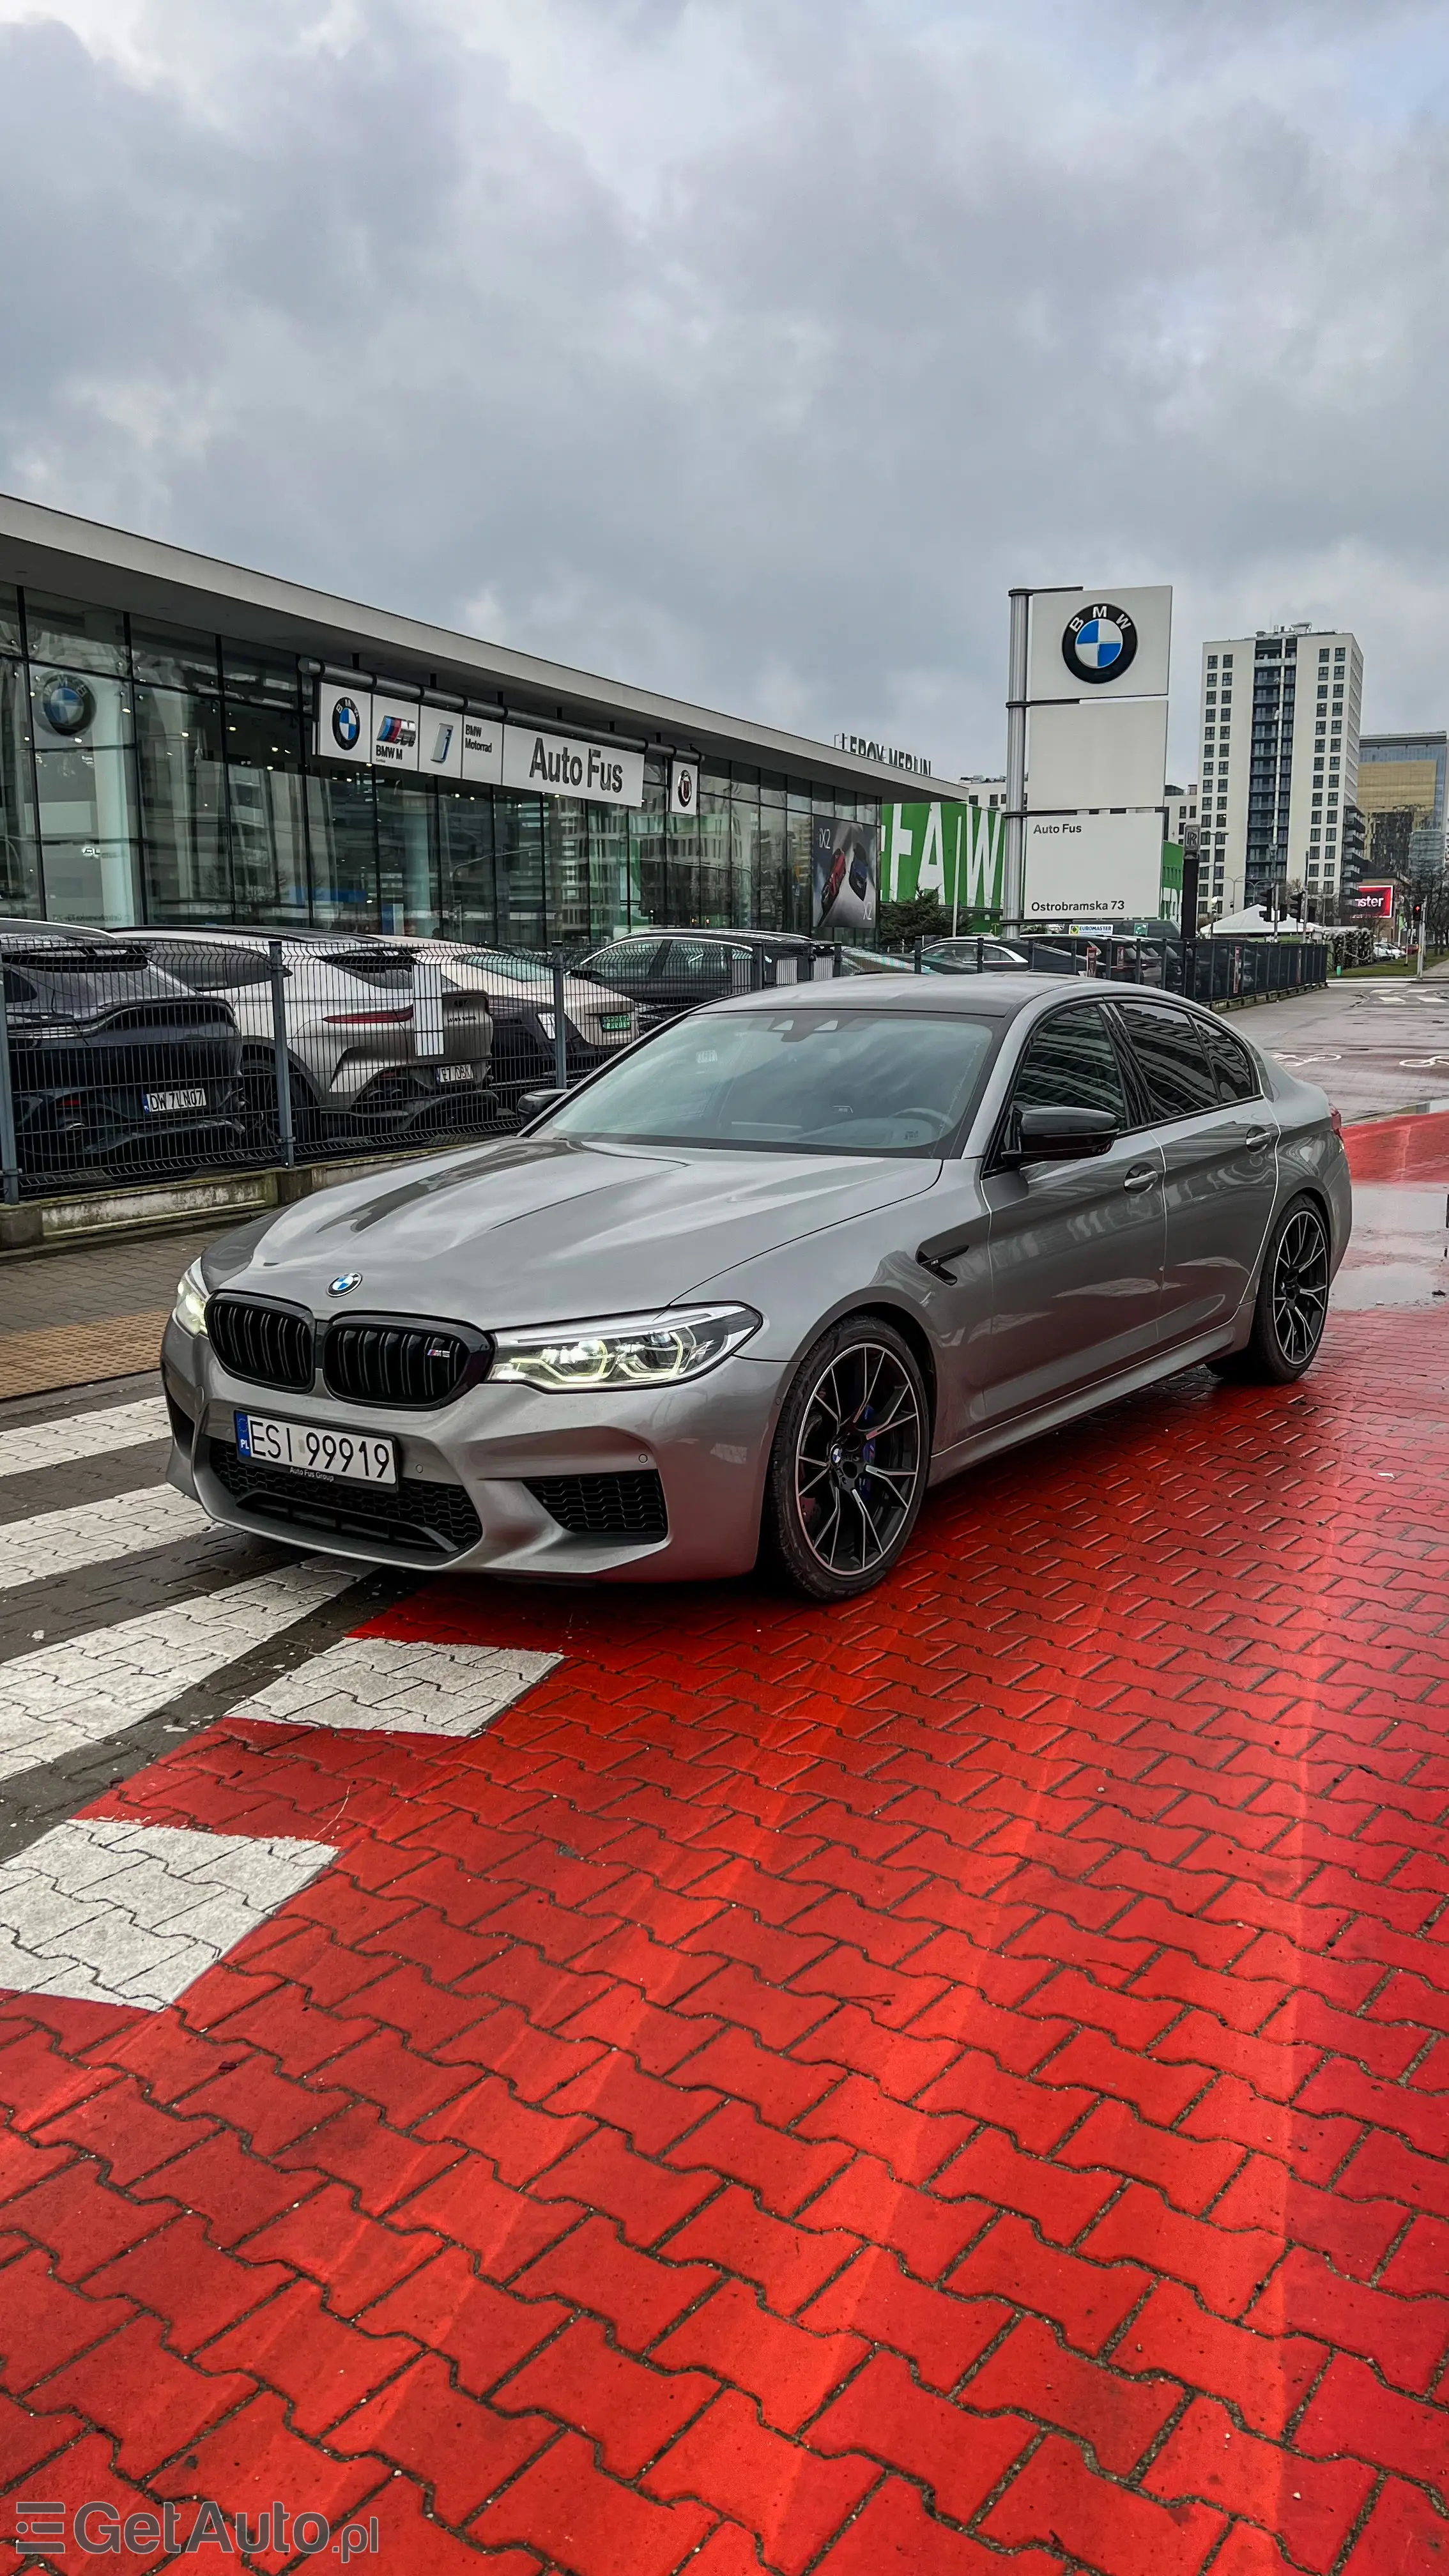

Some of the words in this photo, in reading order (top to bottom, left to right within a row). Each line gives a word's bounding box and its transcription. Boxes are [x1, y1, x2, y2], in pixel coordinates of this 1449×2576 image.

[1070, 606, 1131, 632] BMW
[336, 699, 359, 717] BMW
[465, 724, 482, 738] BMW
[376, 744, 395, 760] BMW
[395, 748, 403, 760] M
[464, 738, 493, 753] Motorrad
[529, 737, 583, 786] Auto
[587, 748, 623, 793] Fus
[1033, 824, 1060, 834] Auto
[1062, 824, 1082, 834] Fus
[1031, 900, 1108, 911] Ostrobramska
[1110, 900, 1125, 910] 73
[150, 1093, 167, 1110] DW
[169, 1090, 203, 1108] 7LN07
[240, 1439, 250, 1450] PL
[250, 1420, 293, 1462] ESI
[306, 1432, 390, 1478] 99919
[289, 1466, 303, 1475] Auto
[304, 1469, 315, 1478] Fus
[316, 1471, 334, 1482] Group
